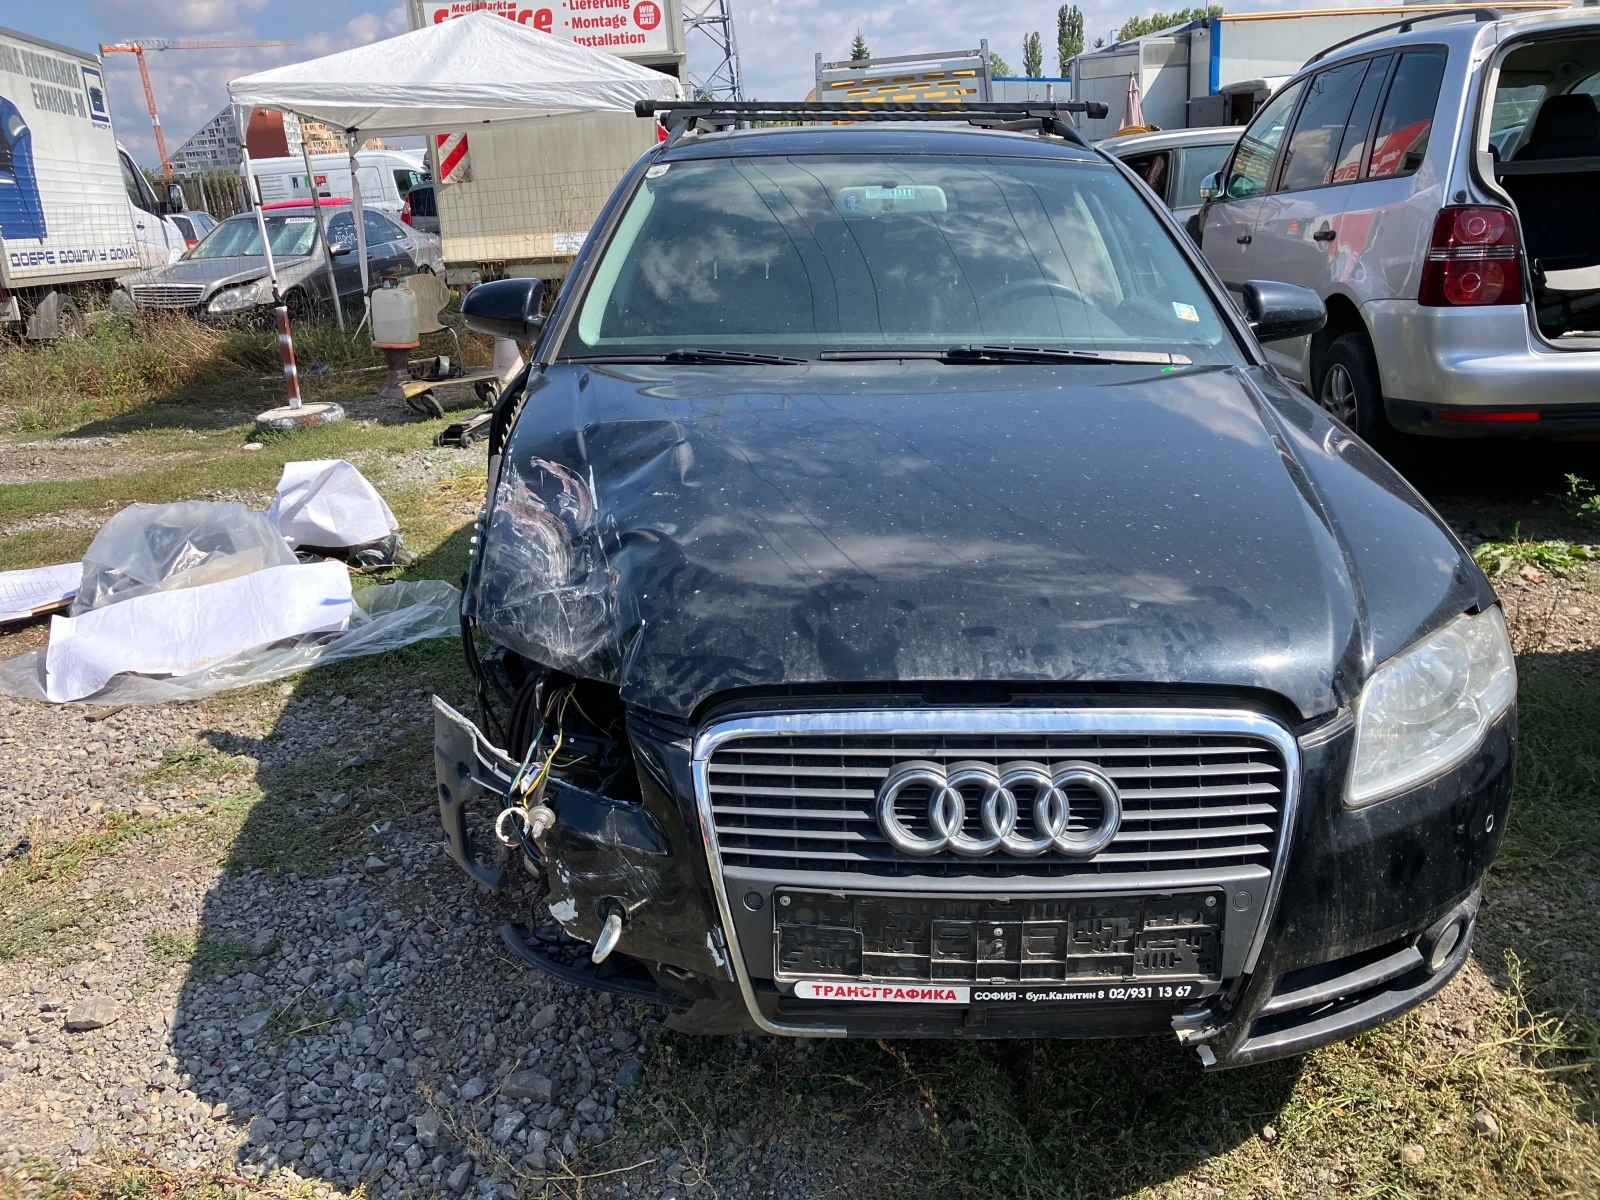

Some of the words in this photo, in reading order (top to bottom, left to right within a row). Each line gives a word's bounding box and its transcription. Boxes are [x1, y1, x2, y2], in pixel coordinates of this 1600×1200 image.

[451, 1, 507, 13] MediaMarkt
[569, 0, 631, 10] Lieferung
[639, 5, 655, 13] WIR
[571, 14, 627, 29] Montage
[573, 32, 646, 47] Installation
[21, 49, 81, 90] КОМПАНИЯ
[30, 82, 87, 119] ЕНИКОМ-М
[10, 250, 56, 267] ДОБРЕ
[60, 248, 98, 264] ДОШЛИ
[98, 248, 107, 261] У
[811, 984, 958, 1001] ТРАНСГРАФИКА
[974, 991, 1017, 1001] СОФИЯ
[1025, 990, 1096, 1002] бул.Калитин
[1097, 990, 1105, 999] 8
[1108, 986, 1152, 1000] 02/931
[1158, 986, 1173, 998] 13
[1175, 985, 1192, 998] 67
